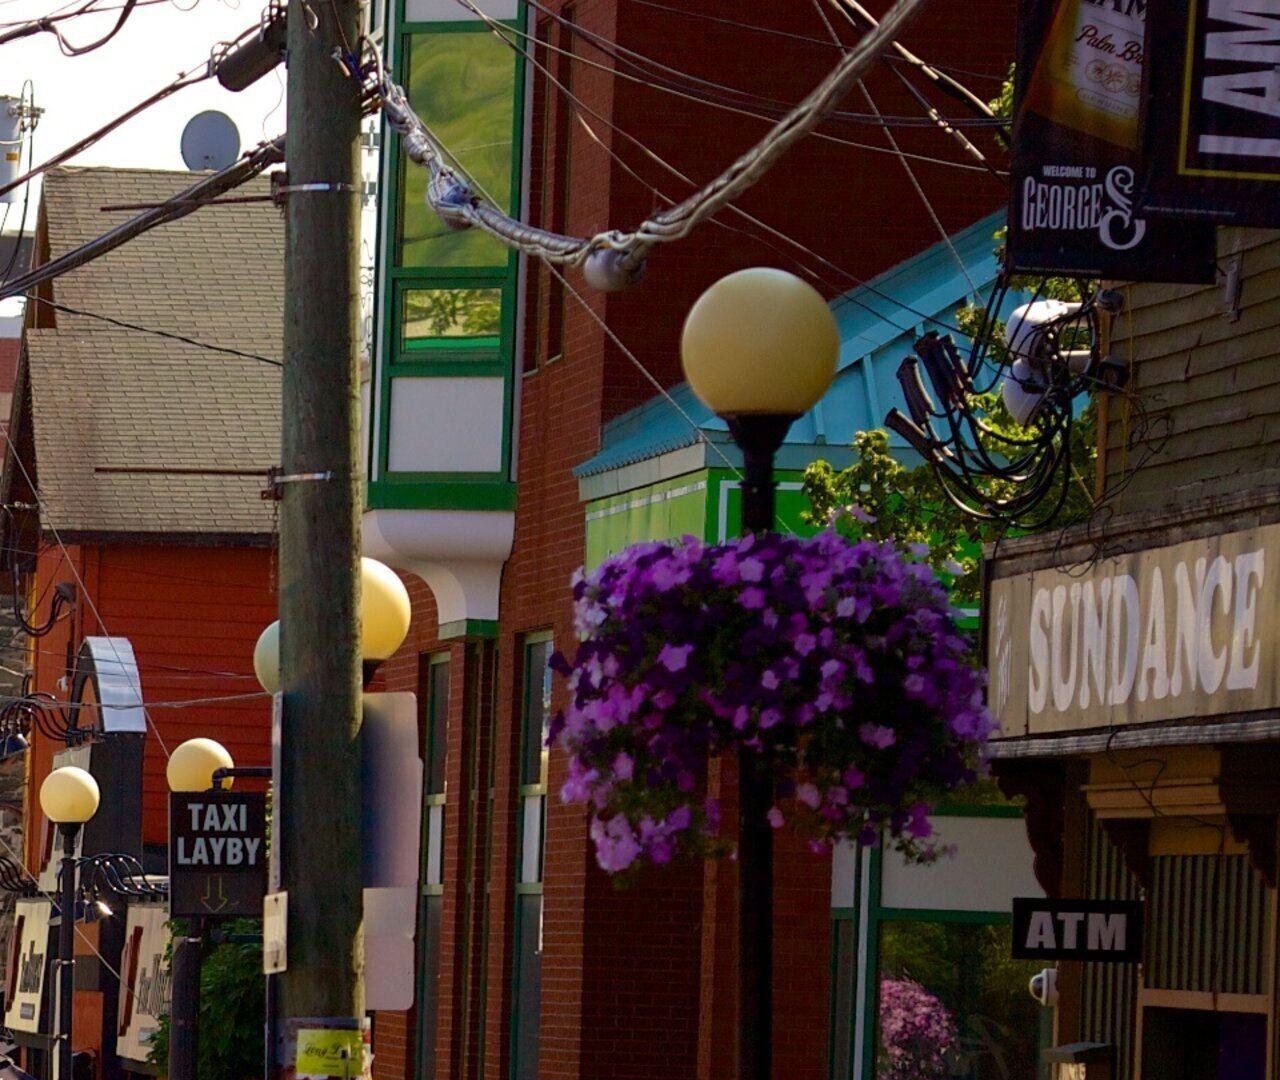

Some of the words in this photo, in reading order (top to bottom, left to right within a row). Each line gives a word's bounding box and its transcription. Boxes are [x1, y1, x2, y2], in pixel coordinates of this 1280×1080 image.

[1075, 24, 1116, 55] Palm
[1042, 165, 1084, 177] WELCOME
[1085, 167, 1097, 178] TO
[1029, 548, 1264, 714] SUNDANCE
[187, 803, 247, 832] TAXI
[177, 836, 260, 866] LAYBY
[1024, 910, 1128, 951] ATM
